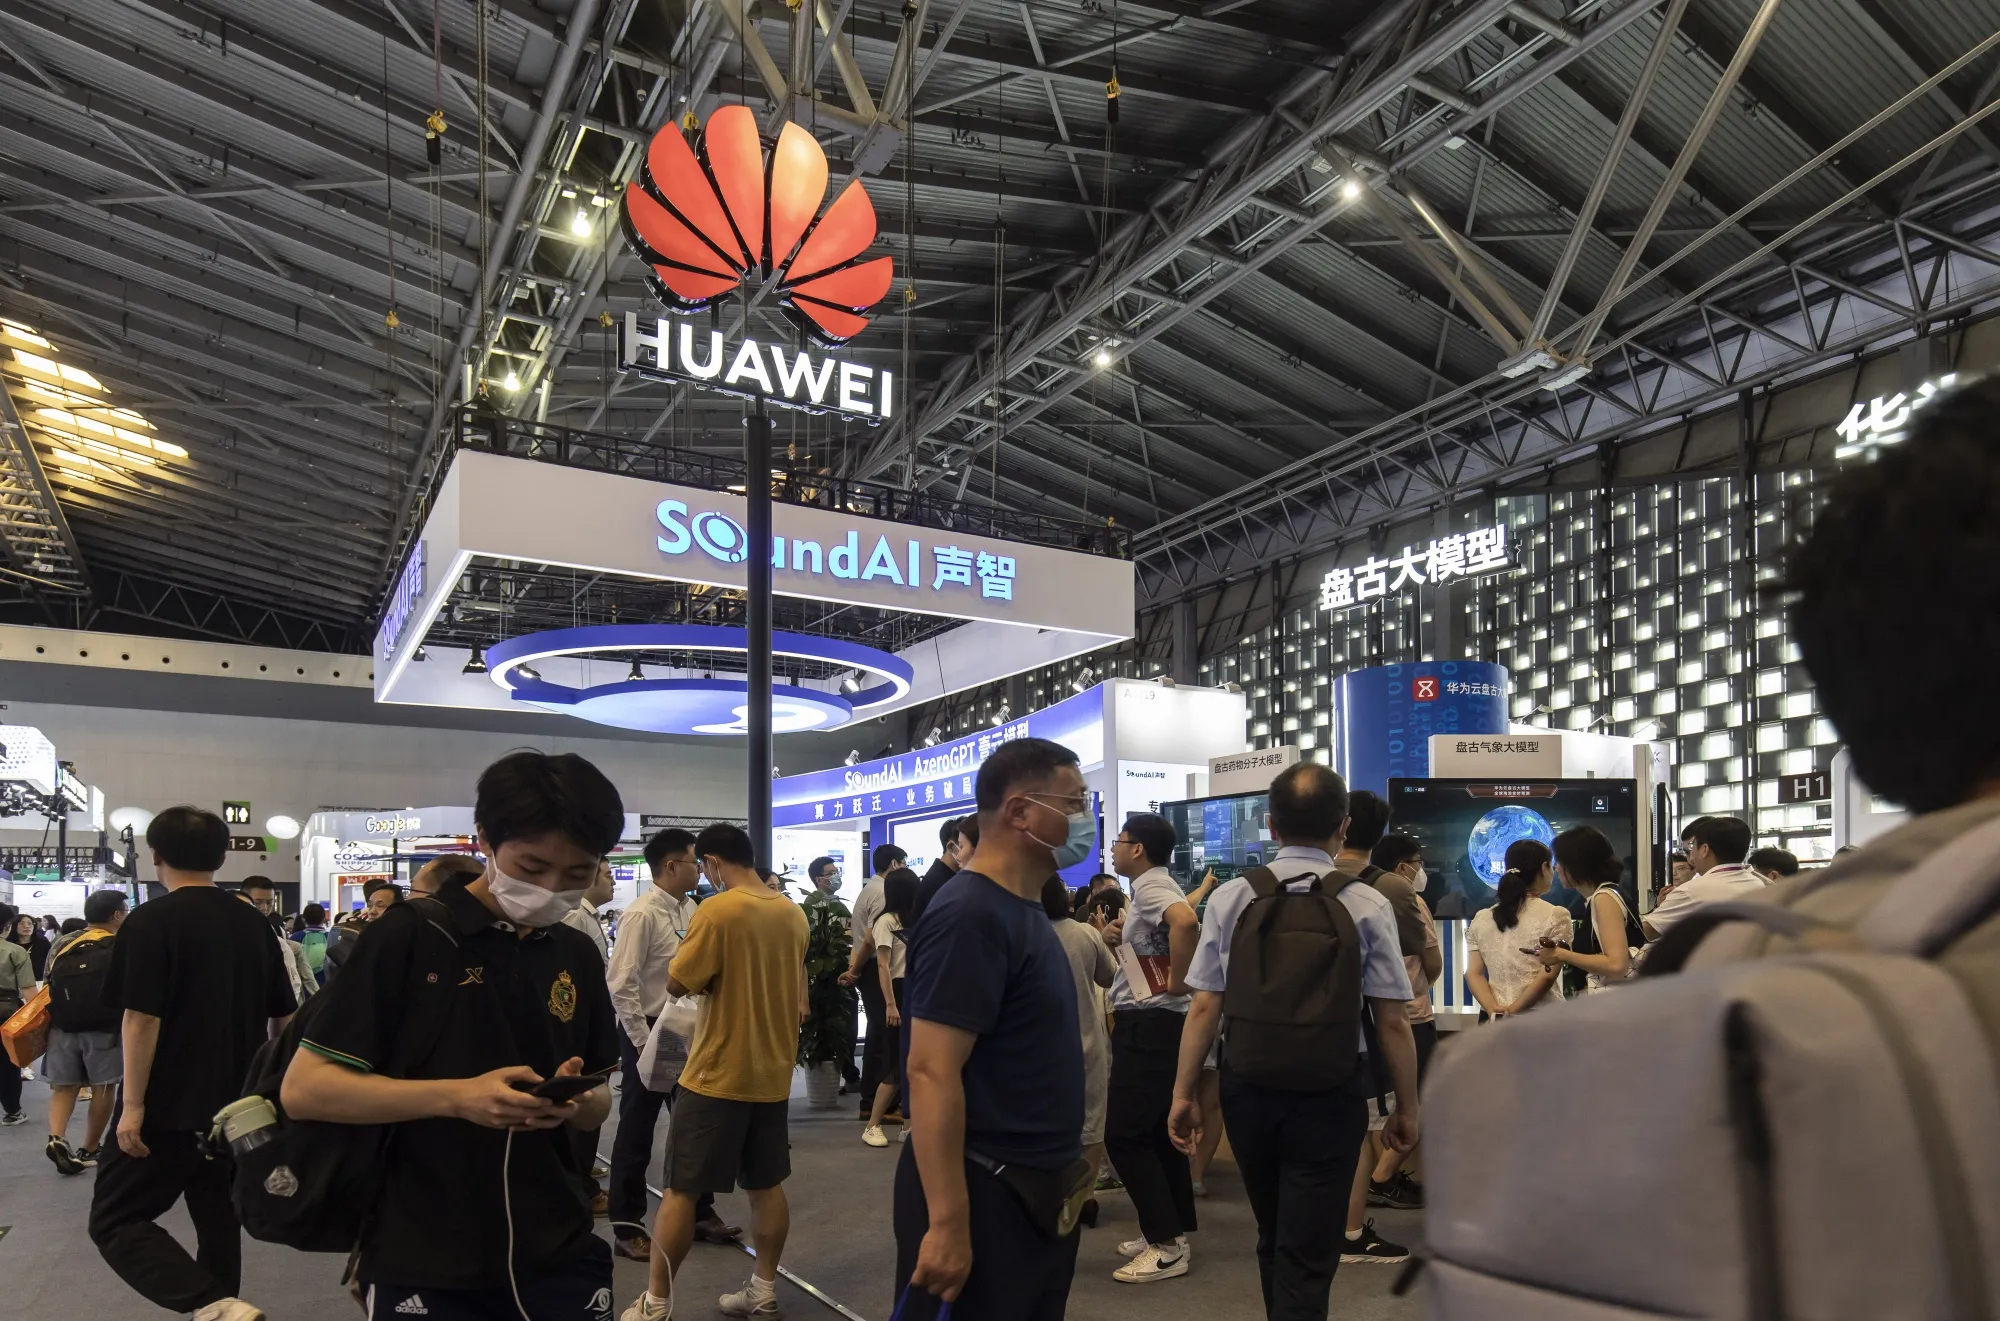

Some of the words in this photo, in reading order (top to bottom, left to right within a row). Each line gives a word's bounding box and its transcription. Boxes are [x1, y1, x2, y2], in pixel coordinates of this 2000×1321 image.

[624, 311, 892, 418] HUAWEI
[931, 545, 1016, 601] 声智
[1320, 524, 1508, 611] 盘古大模型
[1456, 741, 1540, 753] 盘古气象大模型
[844, 761, 902, 792] SoundAI
[914, 741, 976, 780] AzeroGPT
[1214, 753, 1283, 774] 盘古药物分子大模型
[1794, 776, 1824, 799] H1
[365, 813, 405, 837] Google
[334, 853, 378, 861] COS
[395, 1305, 428, 1315] adidas
